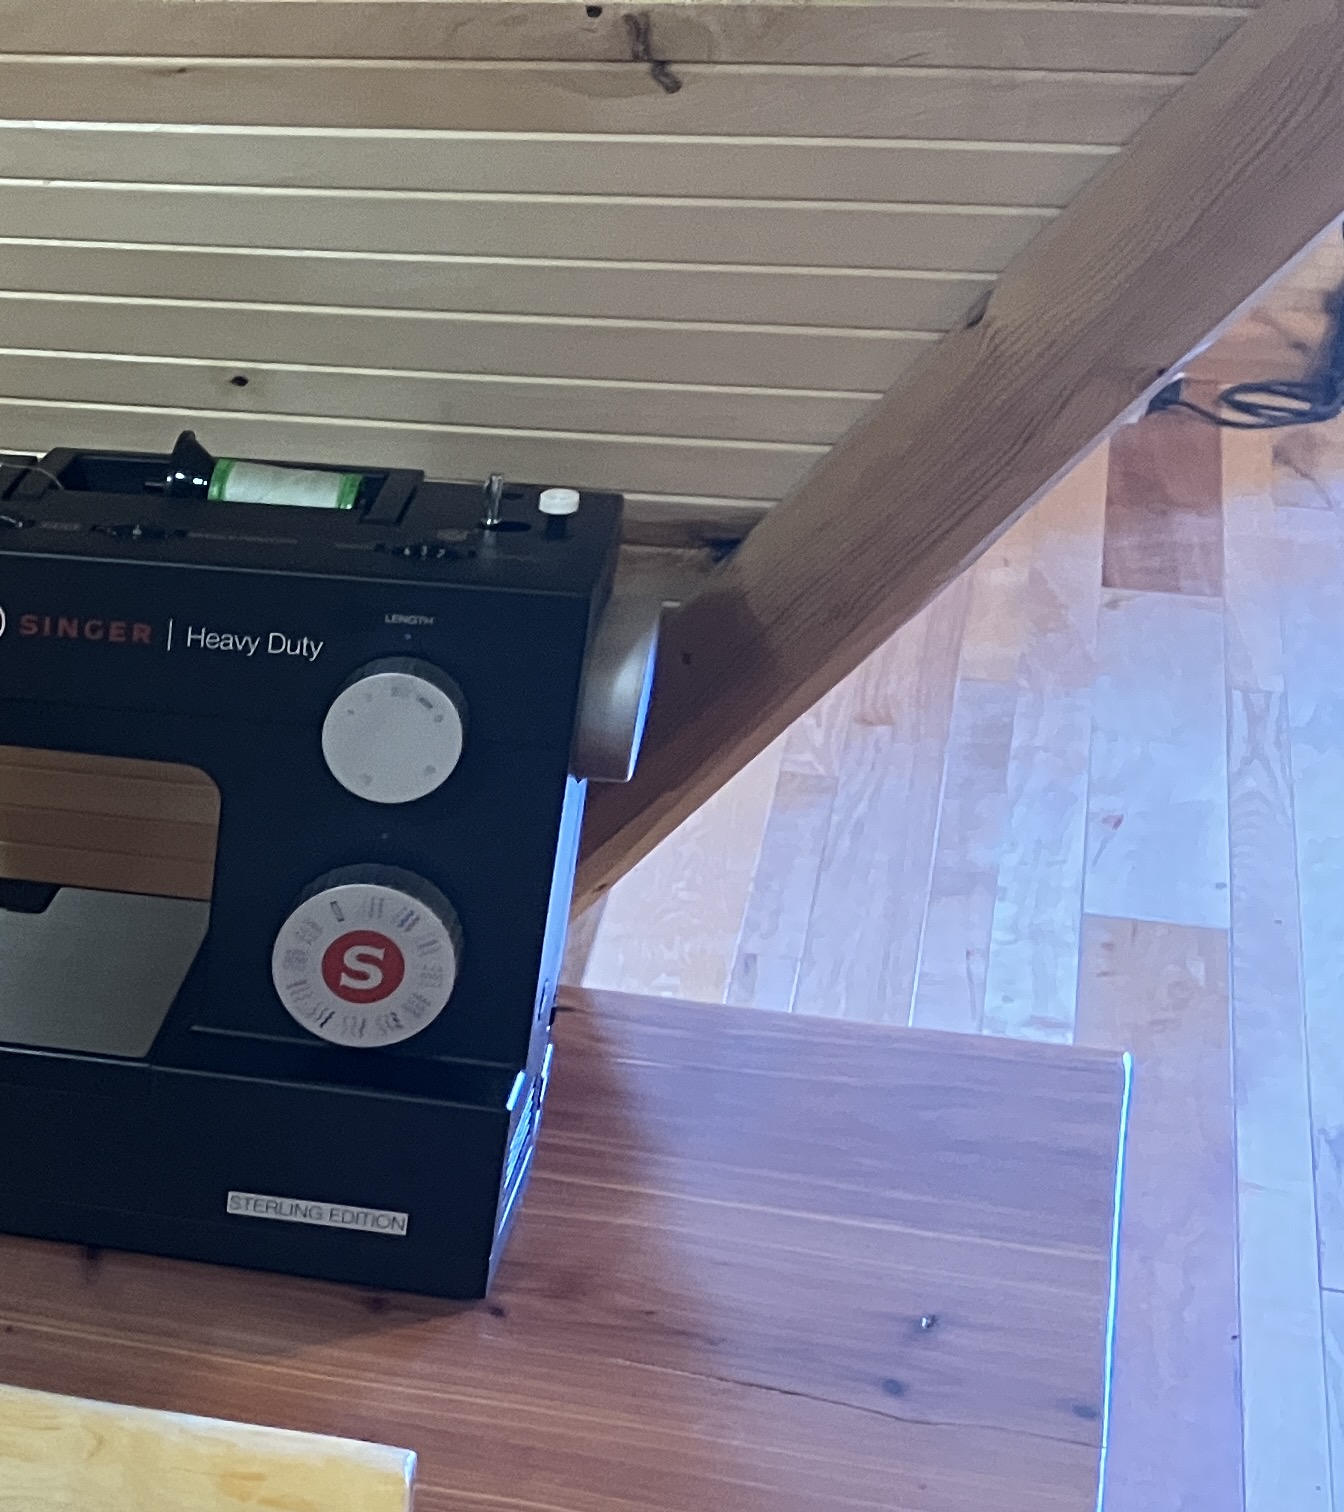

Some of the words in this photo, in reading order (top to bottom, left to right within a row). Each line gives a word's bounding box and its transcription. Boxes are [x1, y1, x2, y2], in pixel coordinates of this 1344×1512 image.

[19, 613, 153, 644] SINGER
[186, 626, 261, 656] Heavy
[267, 632, 324, 661] Duty
[384, 613, 435, 625] LENGTH
[339, 944, 386, 990] S
[228, 1194, 323, 1221] STERLING
[328, 1207, 407, 1232] EDITION
